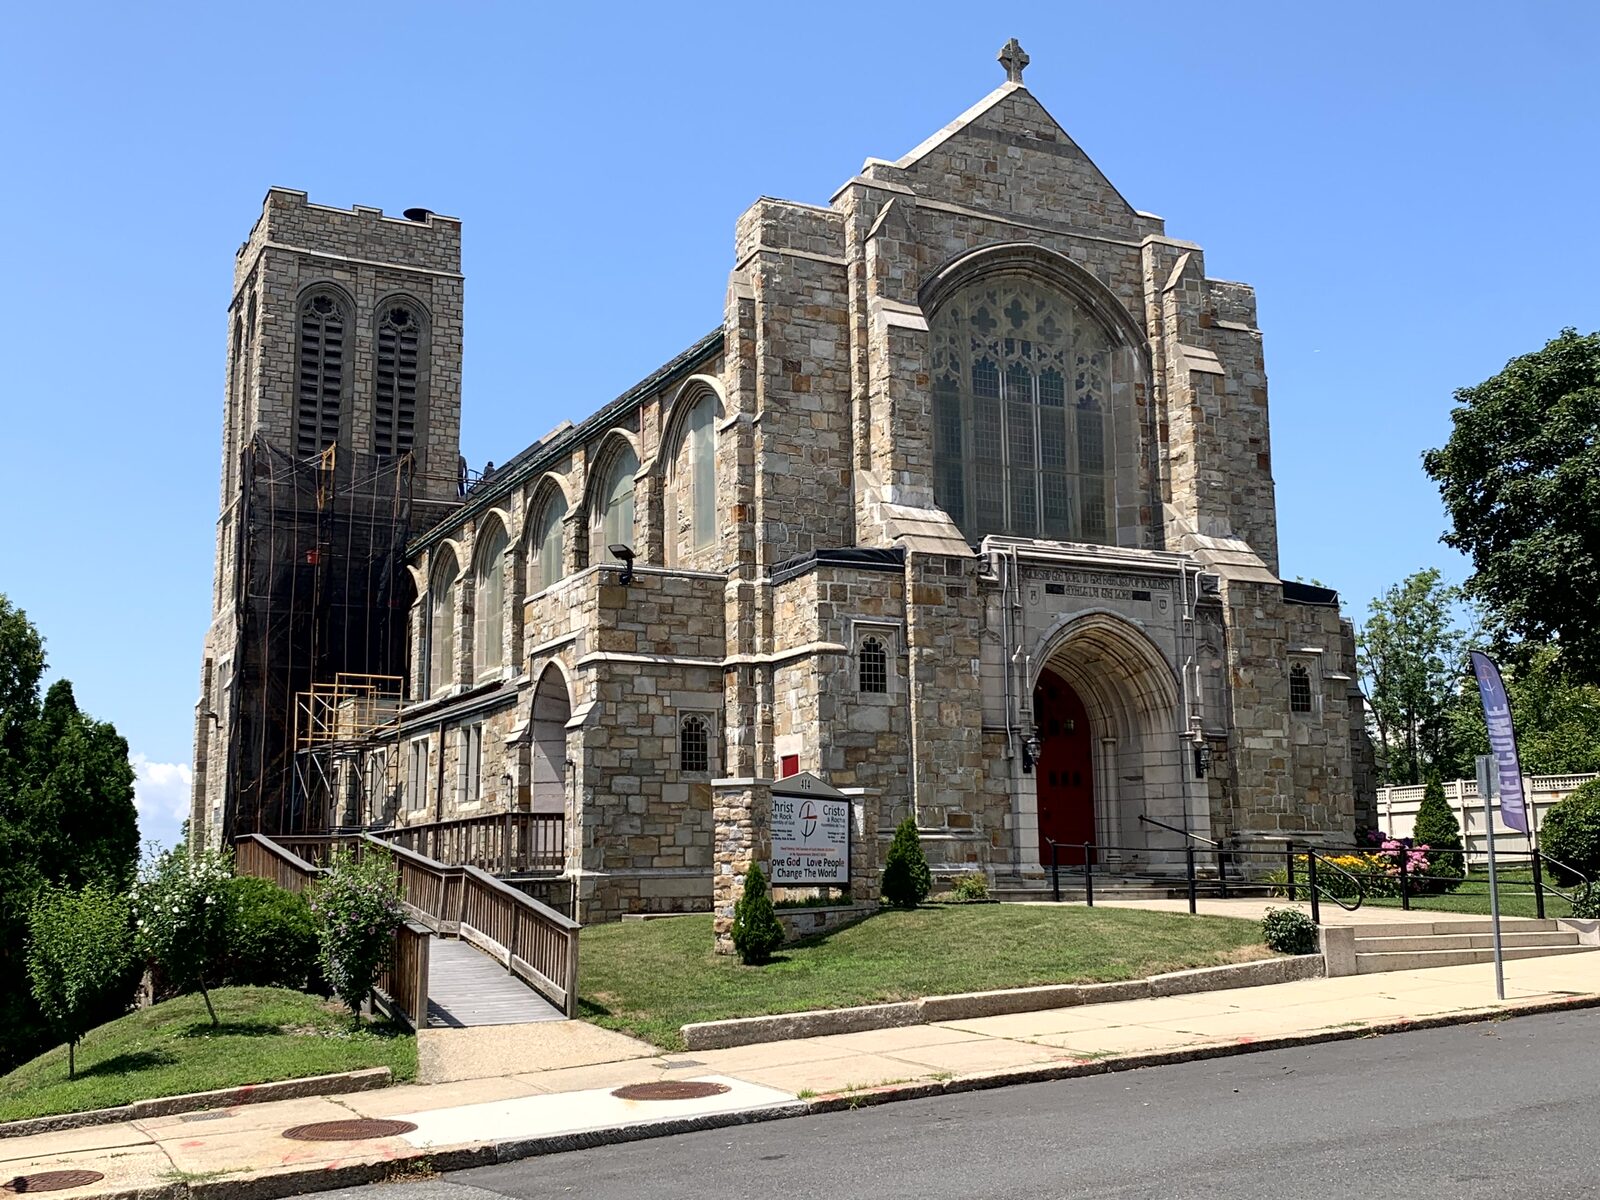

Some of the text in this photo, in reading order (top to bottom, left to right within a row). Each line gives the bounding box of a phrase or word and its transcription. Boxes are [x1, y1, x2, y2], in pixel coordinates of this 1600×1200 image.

[1487, 703, 1523, 814] WELCOME
[801, 779, 811, 790] 414
[779, 812, 792, 820] Rock
[822, 804, 846, 817] Cristo
[771, 857, 845, 869] ove God Love People
[777, 868, 838, 880] Change The World
